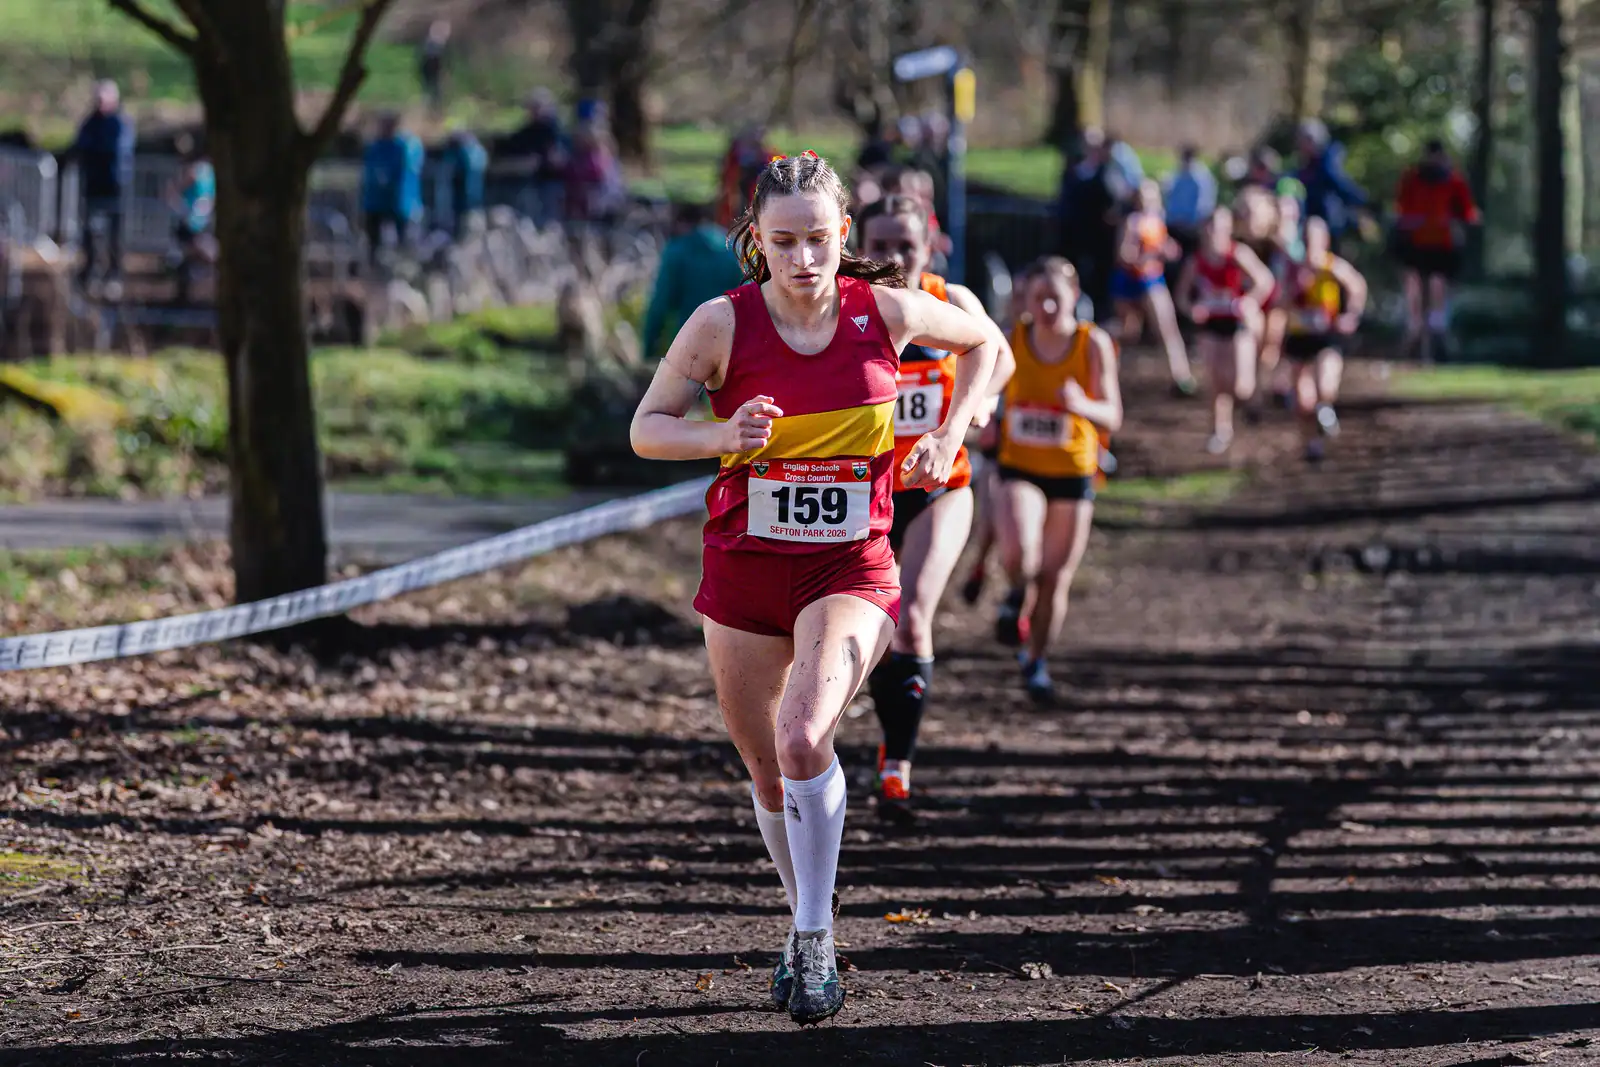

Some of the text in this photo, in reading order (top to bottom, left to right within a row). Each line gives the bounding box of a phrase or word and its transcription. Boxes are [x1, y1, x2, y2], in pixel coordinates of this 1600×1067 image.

[896, 393, 926, 420] 18
[783, 462, 840, 472] English Schools
[785, 473, 836, 483] Cross Country
[771, 486, 848, 525] 159
[770, 525, 847, 538] SEFTON PARK 2026
